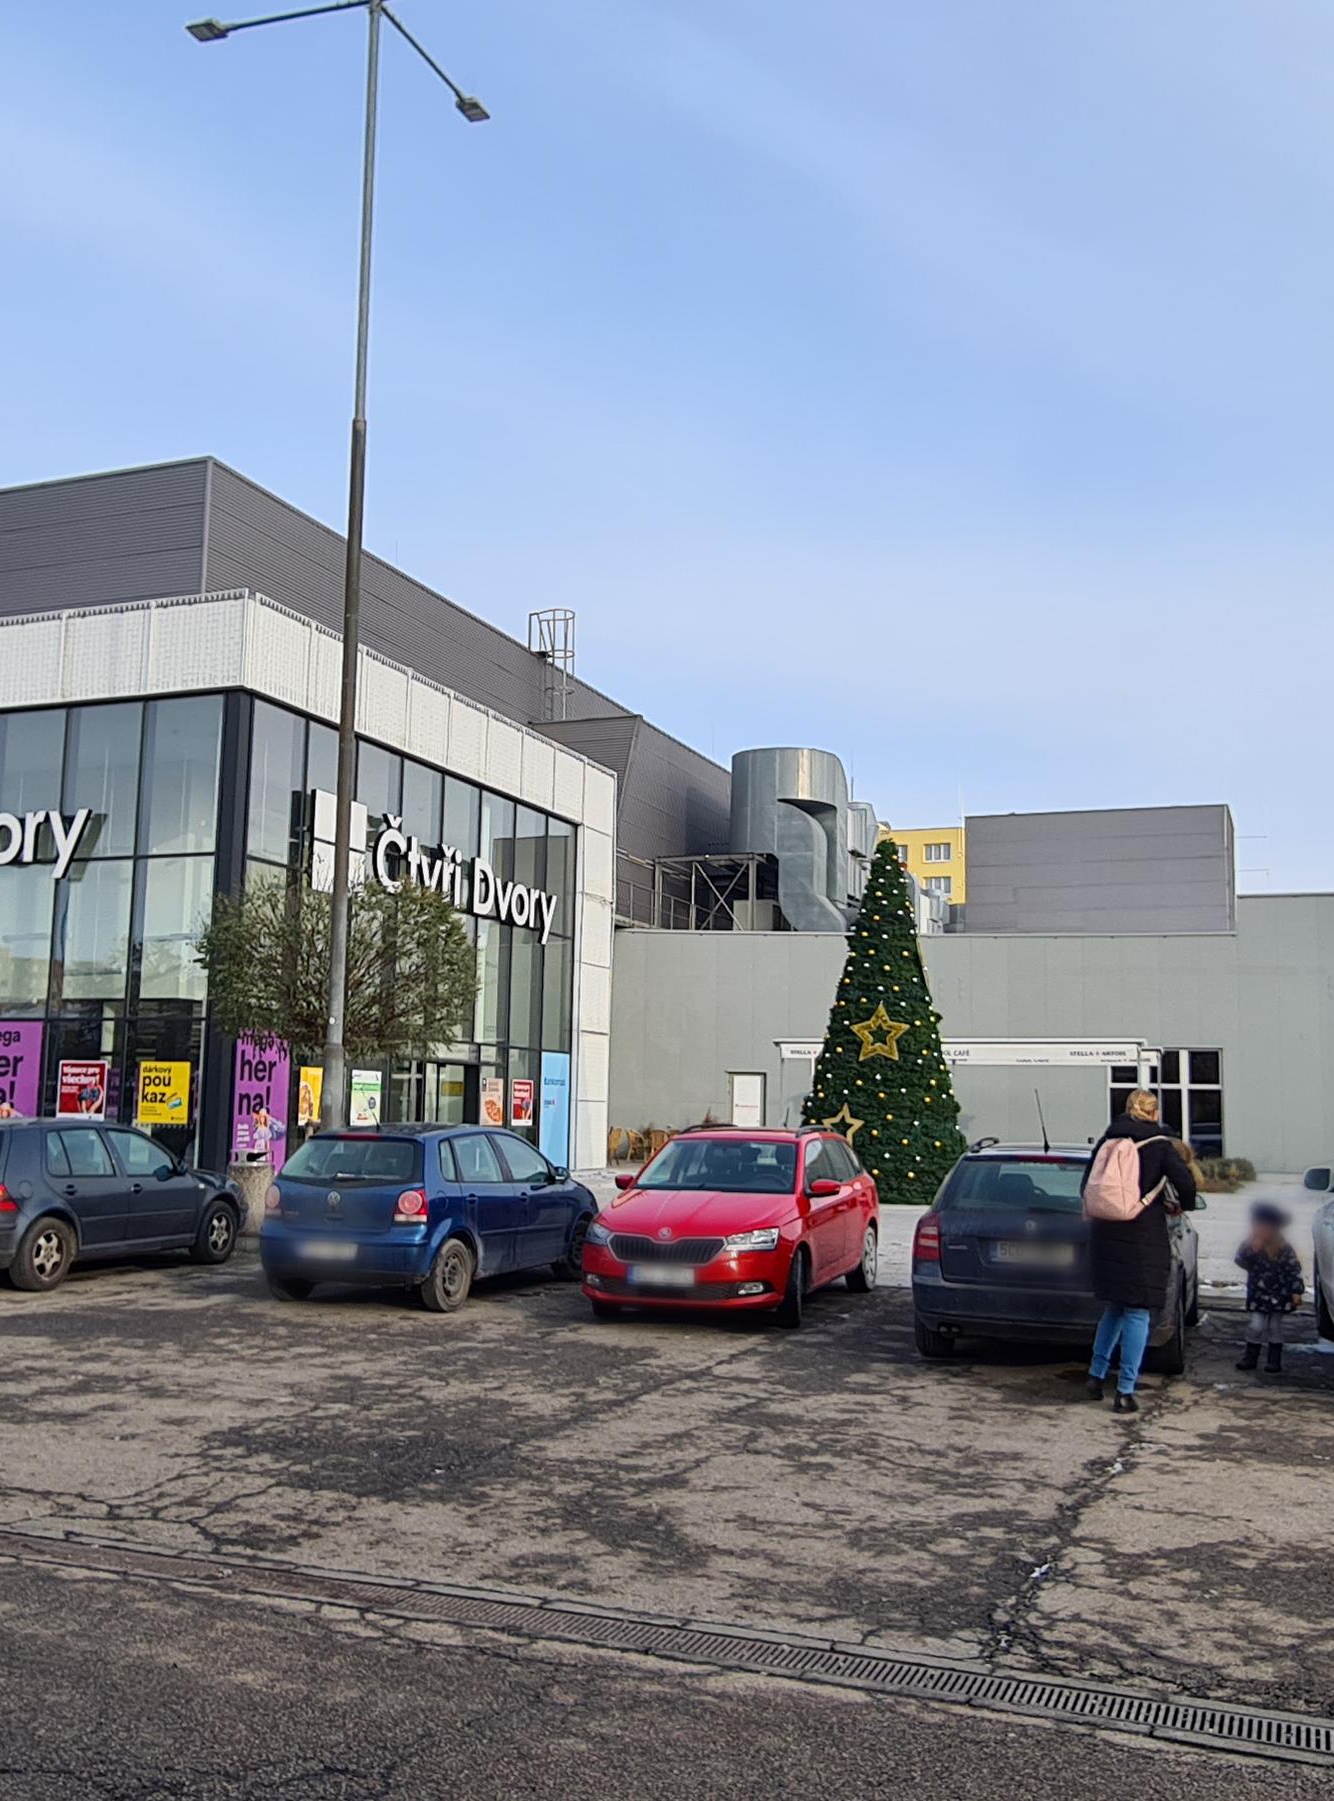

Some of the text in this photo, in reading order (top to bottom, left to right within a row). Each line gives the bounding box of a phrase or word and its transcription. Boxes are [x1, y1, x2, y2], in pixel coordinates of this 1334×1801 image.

[472, 857, 556, 945] Dvory
[143, 1065, 172, 1074] dárkový
[240, 1050, 277, 1082] her
[142, 1075, 171, 1091] pou
[141, 1089, 167, 1104] kaz
[238, 1086, 271, 1116] na!
